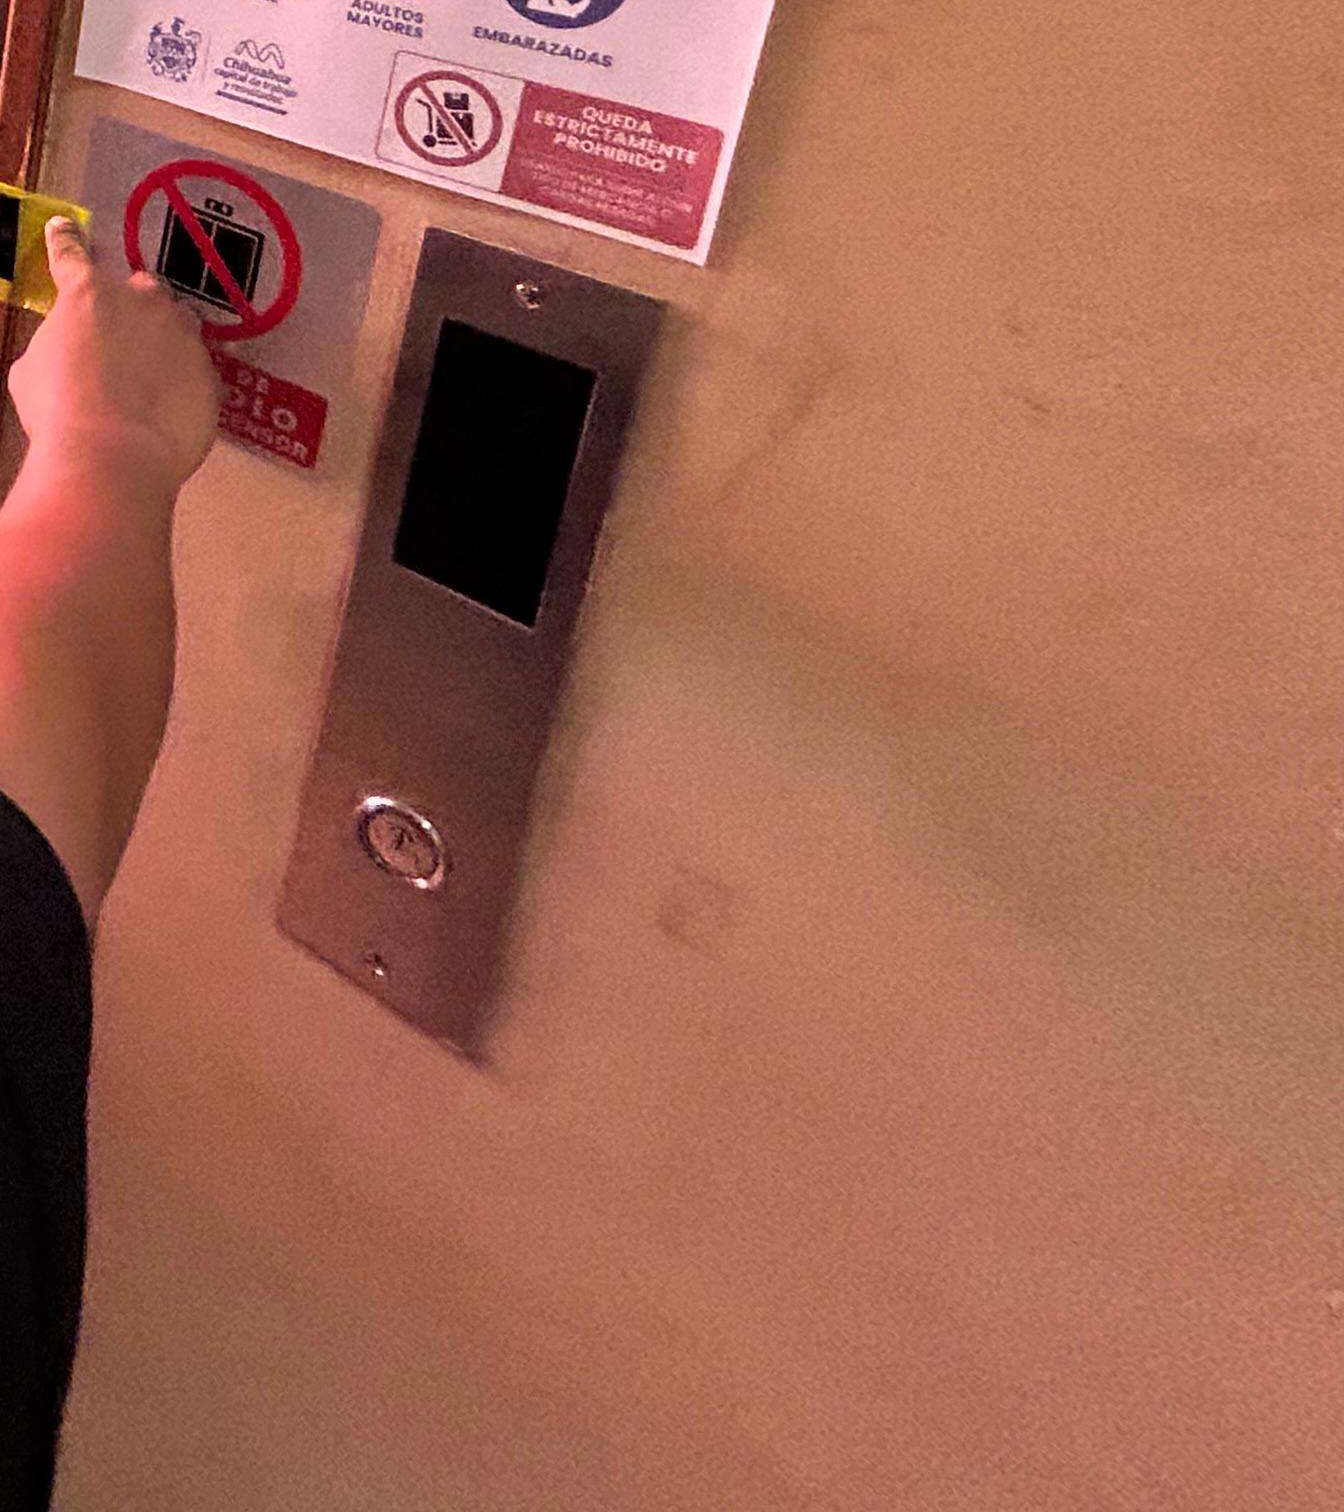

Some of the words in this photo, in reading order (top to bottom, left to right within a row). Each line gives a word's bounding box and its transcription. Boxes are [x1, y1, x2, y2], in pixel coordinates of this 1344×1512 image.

[346, 10, 424, 39] MAYORES
[472, 25, 613, 68] EMBARAZADAS
[533, 110, 699, 165] ESTRICTAMENTE
[582, 105, 653, 135] QUEDA
[554, 132, 668, 173] PROHIBIDO
